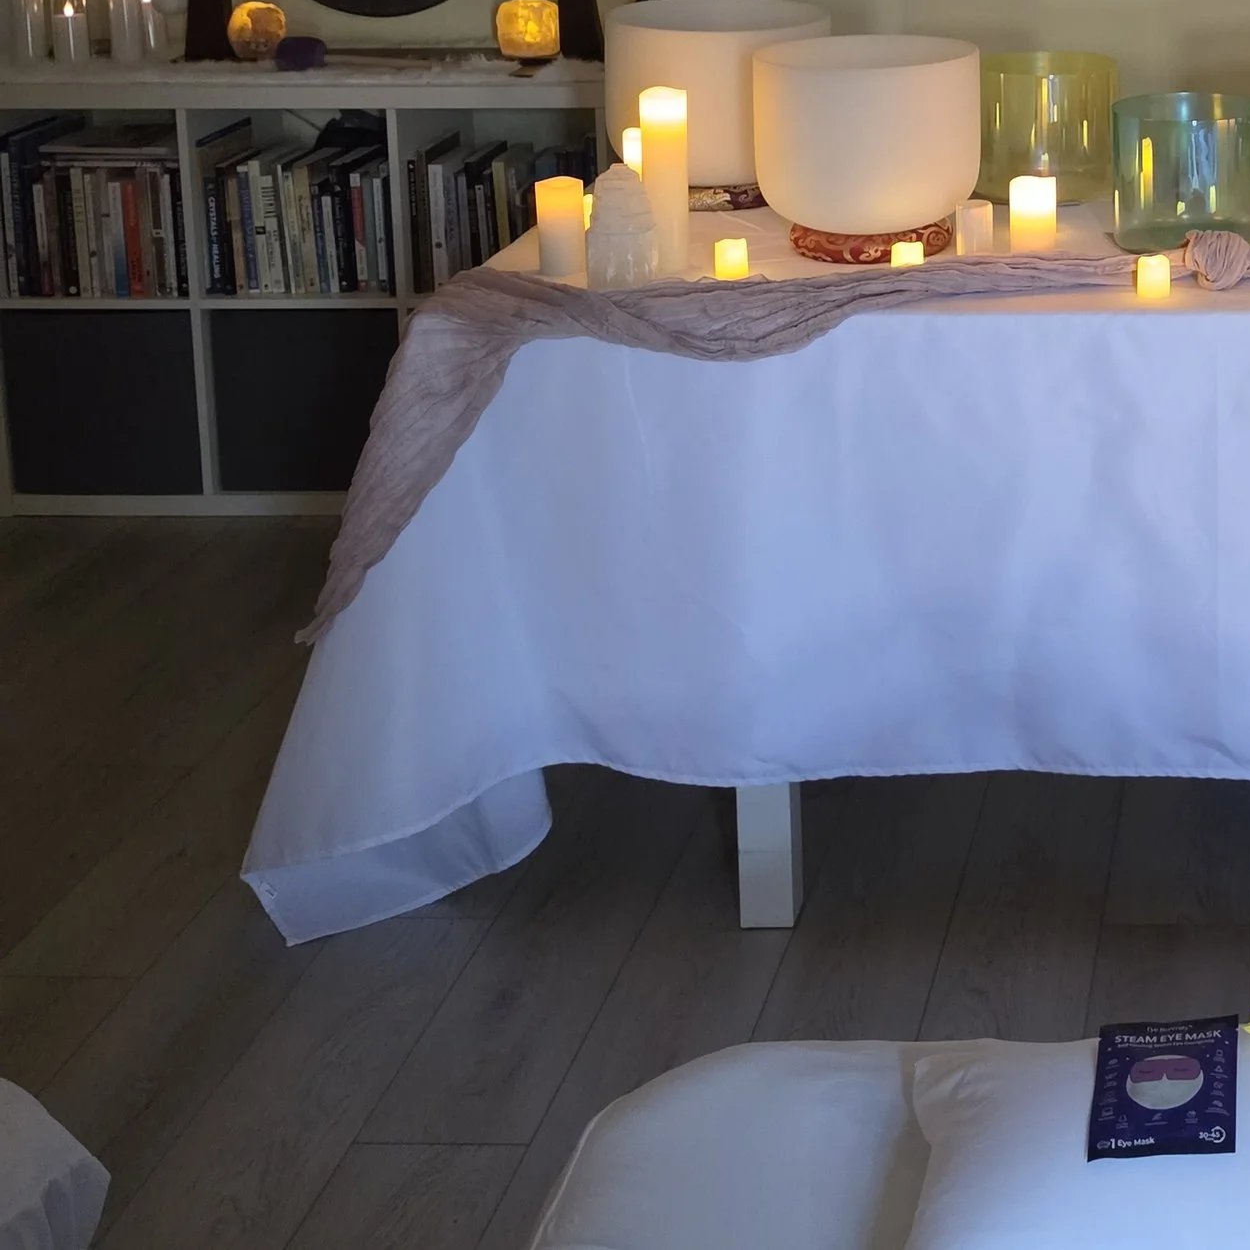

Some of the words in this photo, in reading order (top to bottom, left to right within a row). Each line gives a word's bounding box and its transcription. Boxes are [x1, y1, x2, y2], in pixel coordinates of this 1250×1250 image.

[208, 196, 218, 236] CRYSTALS
[212, 244, 221, 279] HEALING
[1115, 1035, 1157, 1044] STEAM
[1160, 1033, 1183, 1043] EYE
[1185, 1030, 1222, 1041] MASK
[1111, 1139, 1116, 1149] 1
[1118, 1137, 1132, 1149] Eye
[1134, 1135, 1156, 1146] Mask
